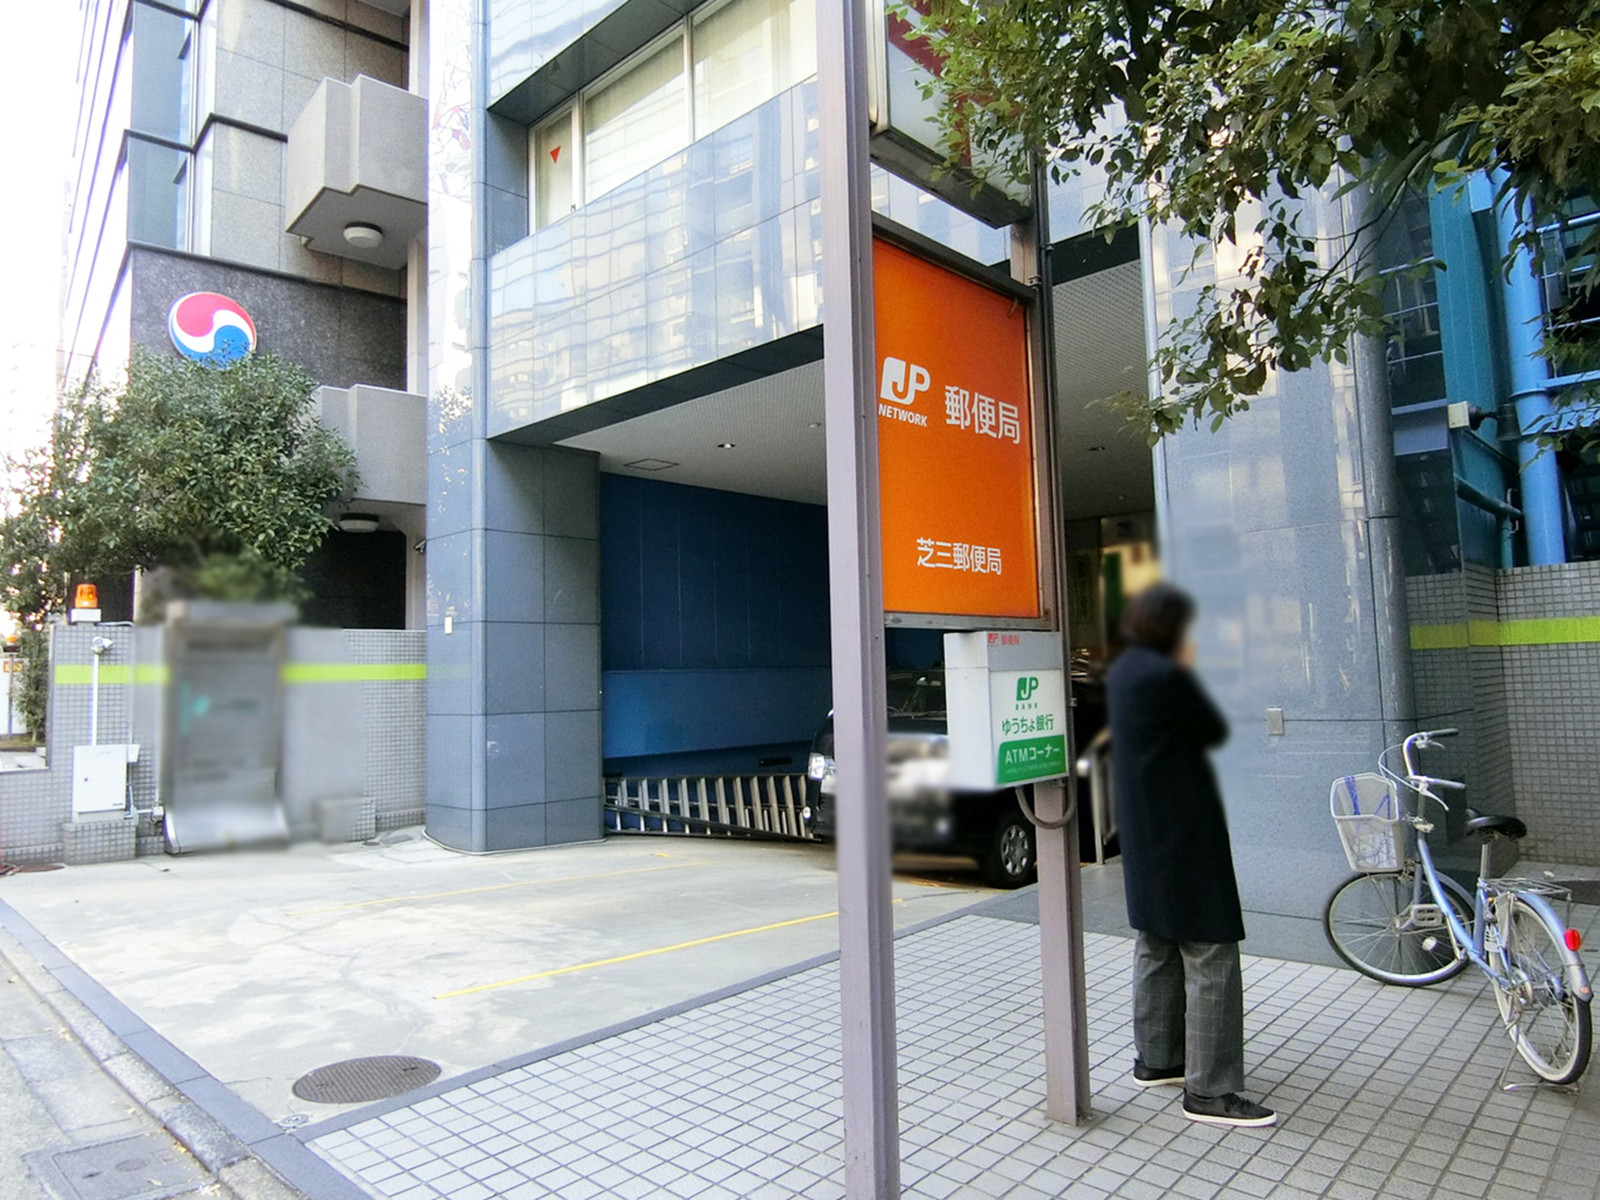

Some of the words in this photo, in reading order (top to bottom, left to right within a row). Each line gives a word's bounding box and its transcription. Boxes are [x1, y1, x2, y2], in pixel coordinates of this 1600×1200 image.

[880, 357, 931, 405] JP
[878, 403, 928, 427] NETWORK
[945, 386, 1021, 444] 郵便局
[916, 537, 1002, 575] 芝三郵便局
[1016, 677, 1039, 701] JP
[1015, 702, 1038, 711] BANK
[1002, 713, 1054, 735] ゆうちょ銀行
[1005, 744, 1060, 765] ATMコーナー
